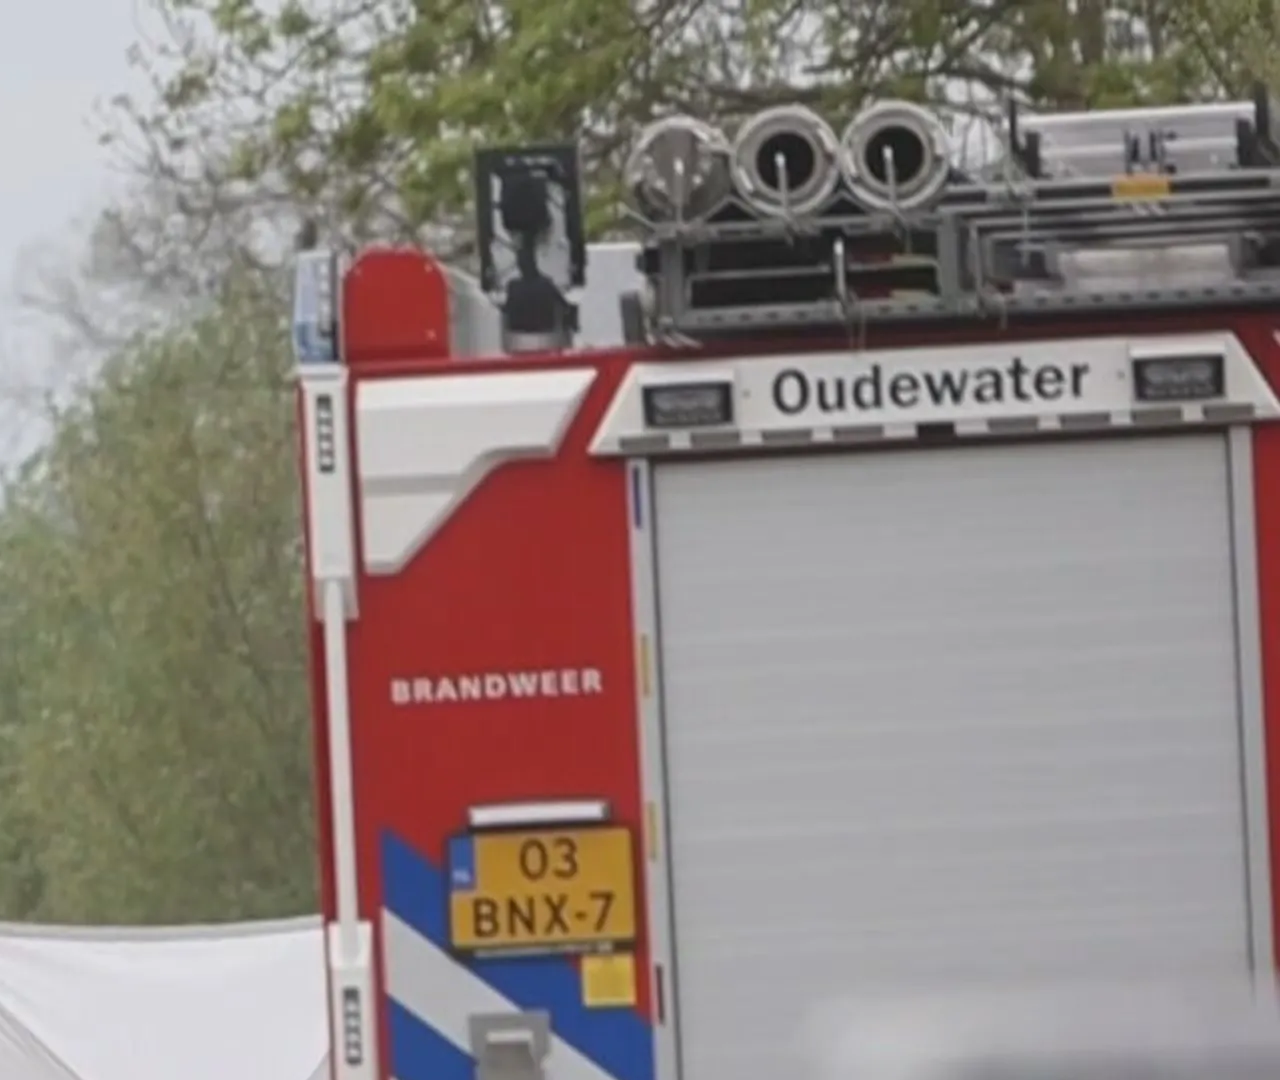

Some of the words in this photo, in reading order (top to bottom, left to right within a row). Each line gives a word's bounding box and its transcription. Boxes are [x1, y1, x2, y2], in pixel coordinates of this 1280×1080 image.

[772, 357, 1089, 415] Oudewater
[391, 668, 603, 704] BRANDWEER
[518, 837, 579, 881] 03
[473, 890, 615, 938] BNX-7
